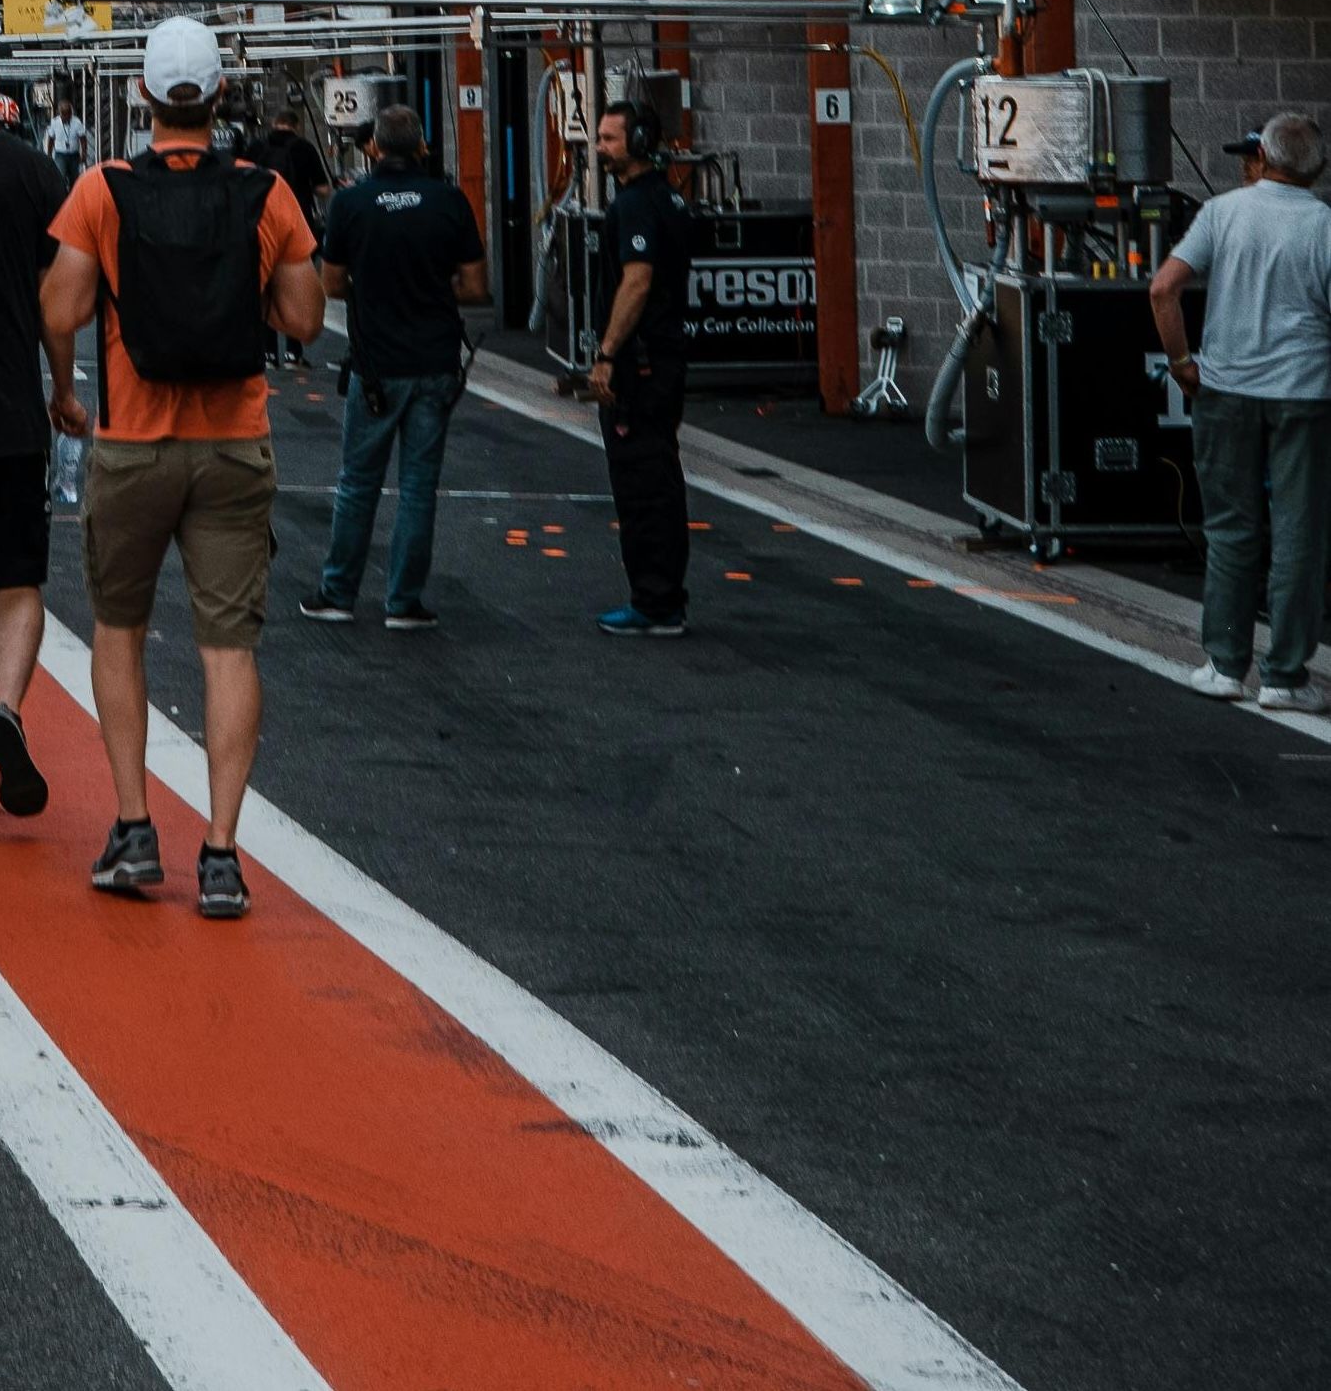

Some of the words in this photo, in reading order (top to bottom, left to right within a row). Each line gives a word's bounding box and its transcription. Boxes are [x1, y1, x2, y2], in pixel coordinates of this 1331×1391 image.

[334, 91, 358, 113] 25
[826, 93, 839, 120] 6
[981, 95, 1018, 146] 12
[688, 269, 816, 307] reso
[703, 317, 733, 333] Car
[736, 316, 815, 334] Collection
